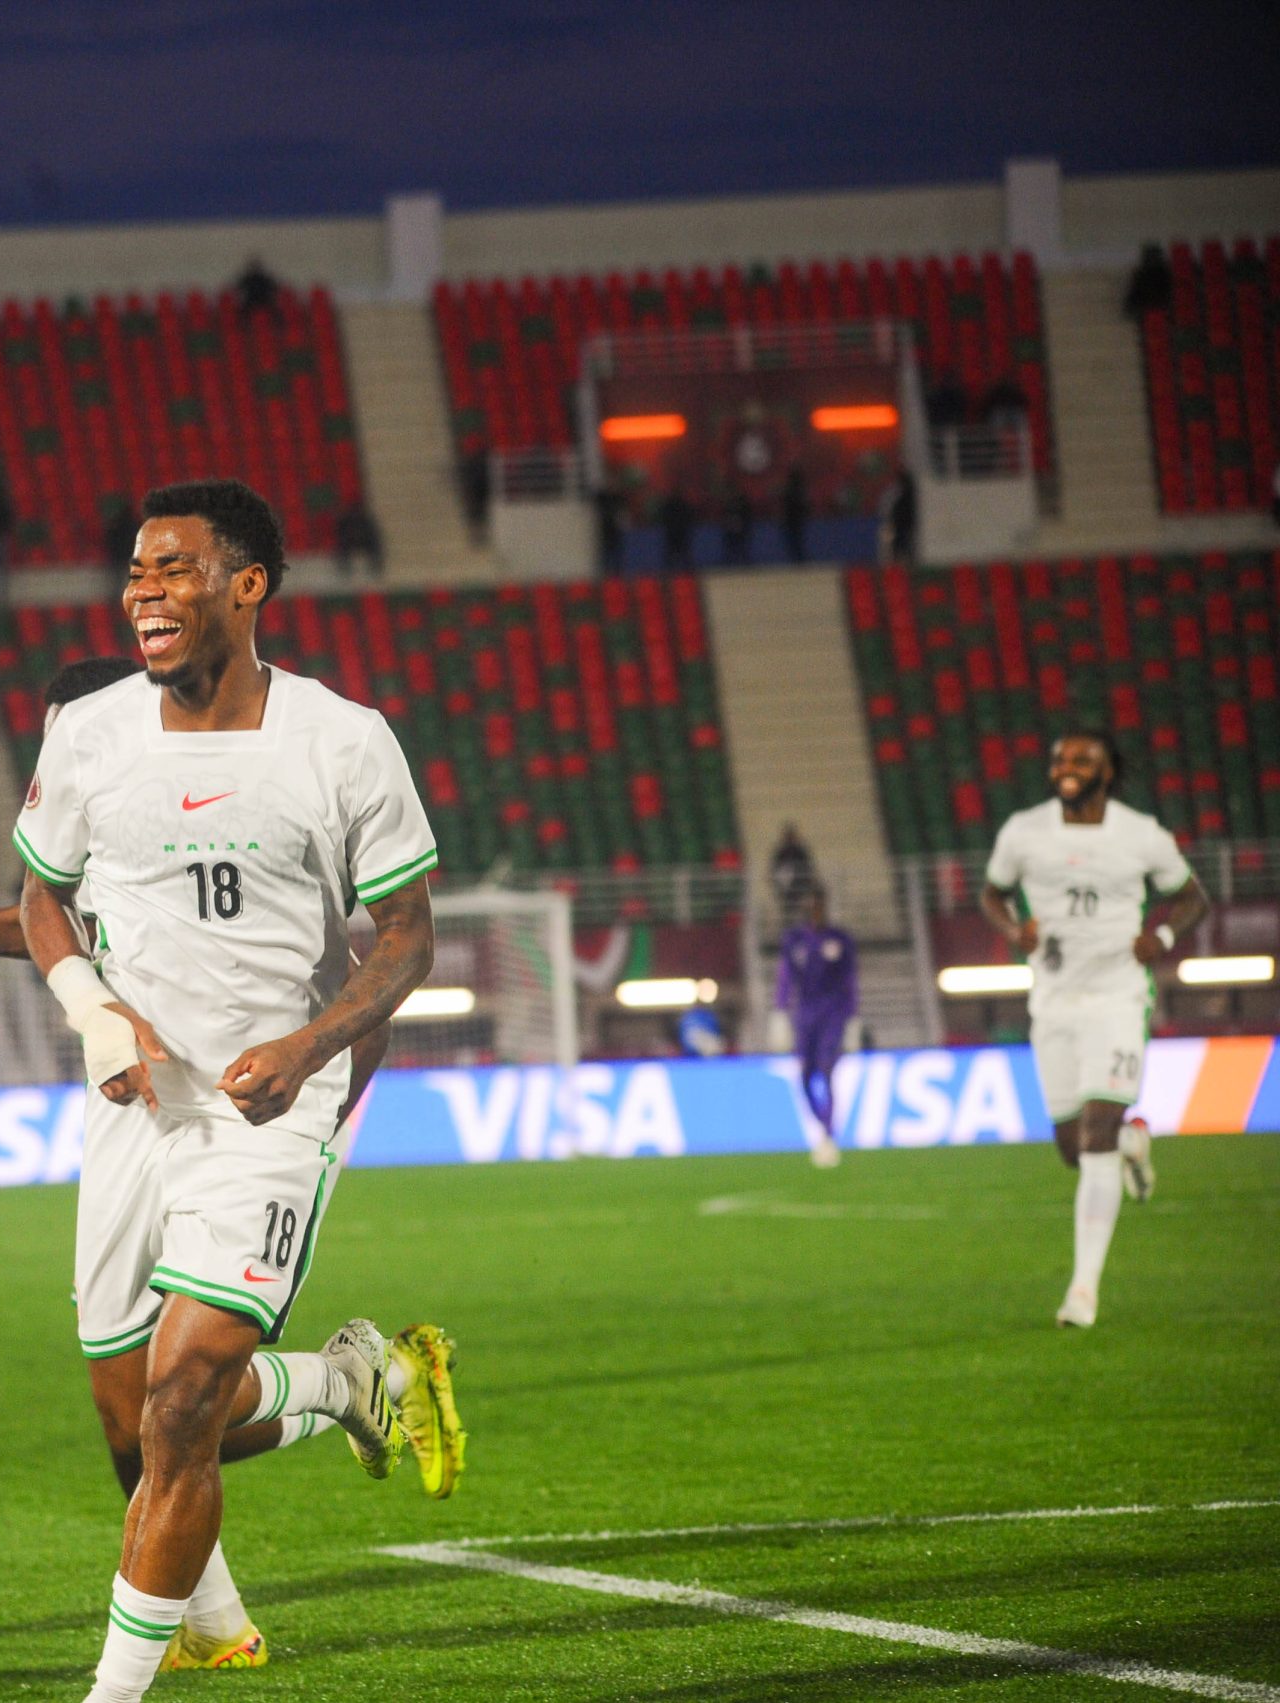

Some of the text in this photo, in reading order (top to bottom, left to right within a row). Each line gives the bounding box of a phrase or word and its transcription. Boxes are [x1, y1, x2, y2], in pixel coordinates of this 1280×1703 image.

[163, 842, 260, 853] NAIJA
[187, 862, 243, 922] 18
[1066, 886, 1099, 918] 20
[1111, 1050, 1140, 1081] 20
[424, 1061, 687, 1163] VISA
[767, 1049, 1027, 1148] VISA
[261, 1200, 297, 1271] 18
